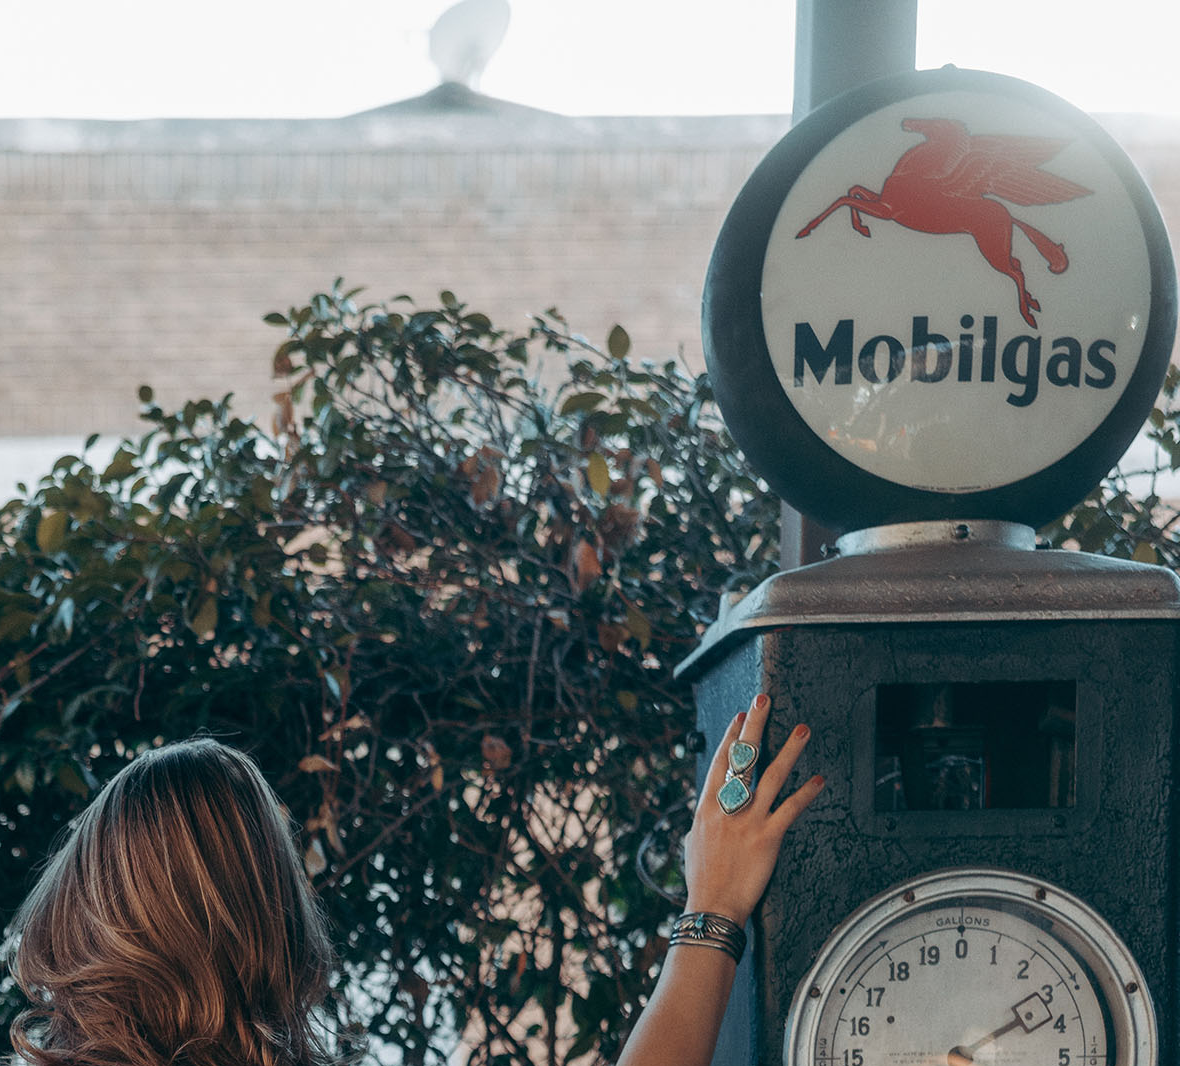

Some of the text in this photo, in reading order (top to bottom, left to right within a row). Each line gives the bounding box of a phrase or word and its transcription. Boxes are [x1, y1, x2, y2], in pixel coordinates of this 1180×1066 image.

[793, 314, 1117, 407] Mobilgas
[935, 917, 991, 928] GALLONS
[919, 945, 940, 966] 19
[955, 938, 969, 959] 0
[989, 946, 998, 965] 1
[888, 961, 910, 981] 18
[1017, 961, 1030, 980] 2
[865, 987, 886, 1007] 17
[1041, 984, 1054, 1004] 3
[850, 1016, 870, 1036] 16
[1053, 1014, 1067, 1034] 4
